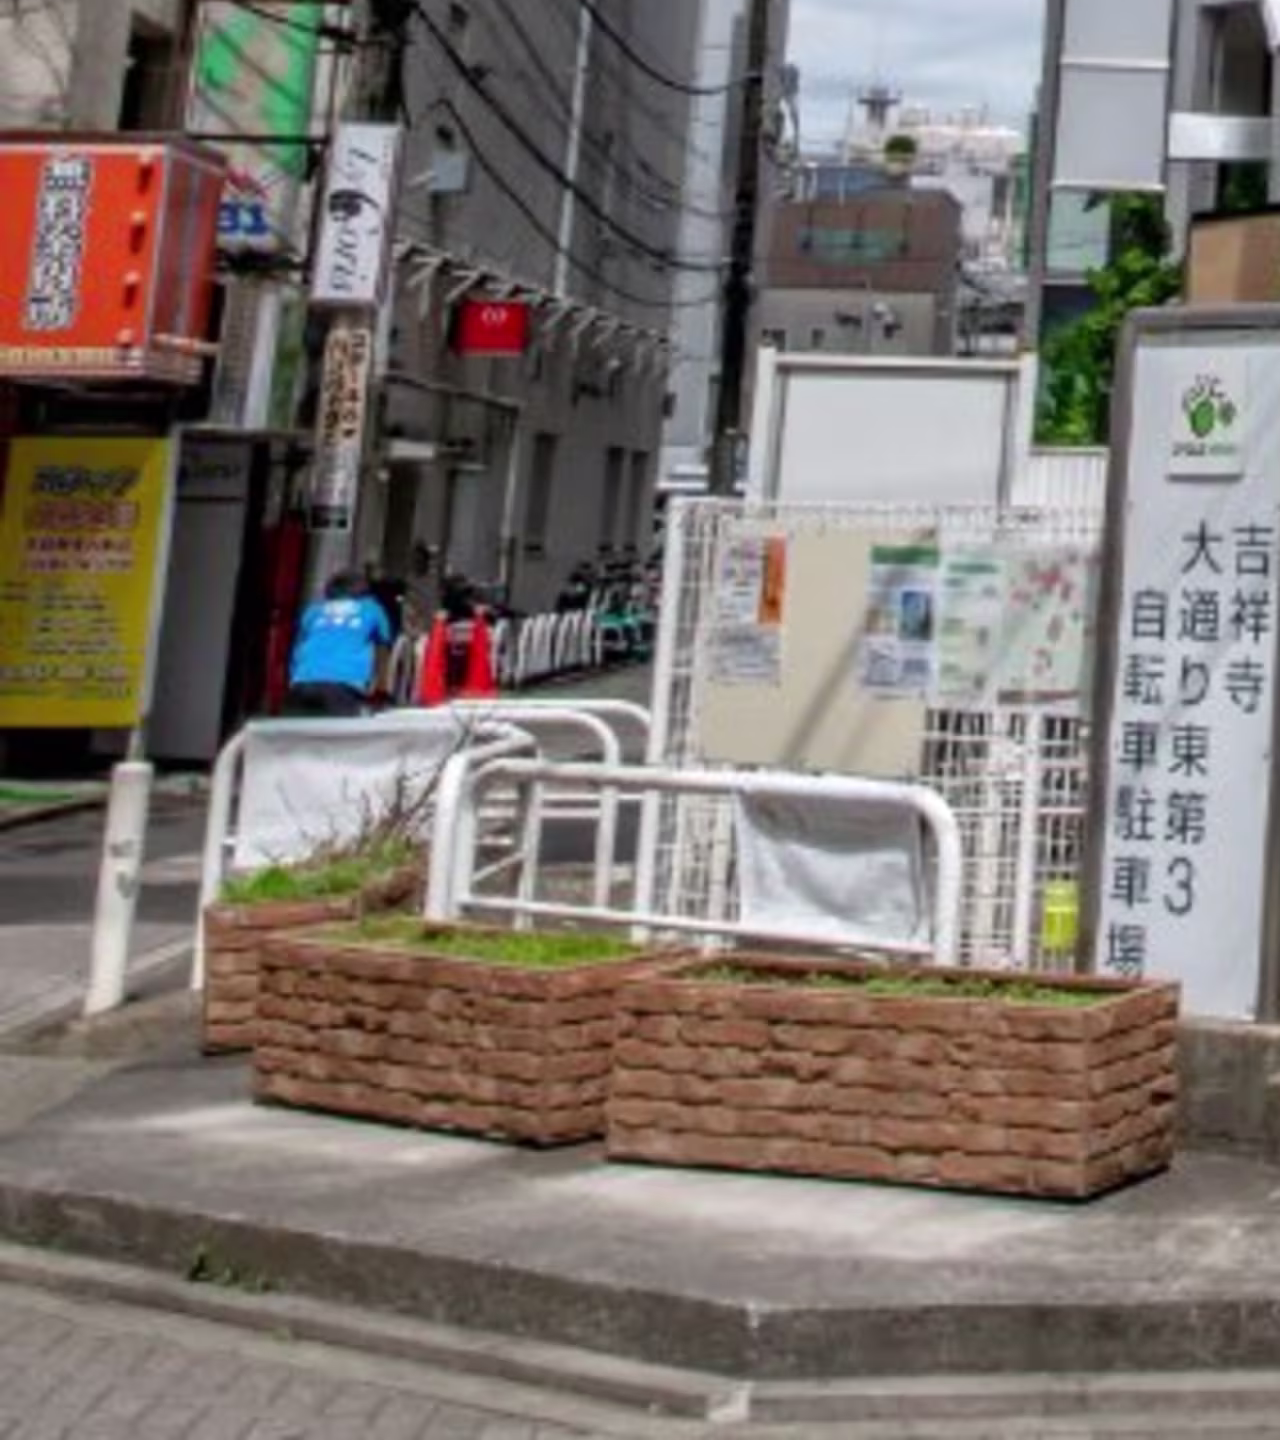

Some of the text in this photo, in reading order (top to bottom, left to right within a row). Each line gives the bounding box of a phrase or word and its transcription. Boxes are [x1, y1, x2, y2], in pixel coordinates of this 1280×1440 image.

[1105, 587, 1169, 978] 自転車駐車場
[1162, 518, 1224, 917] 大通り東第3
[1224, 523, 1274, 715] 吉祥寺
